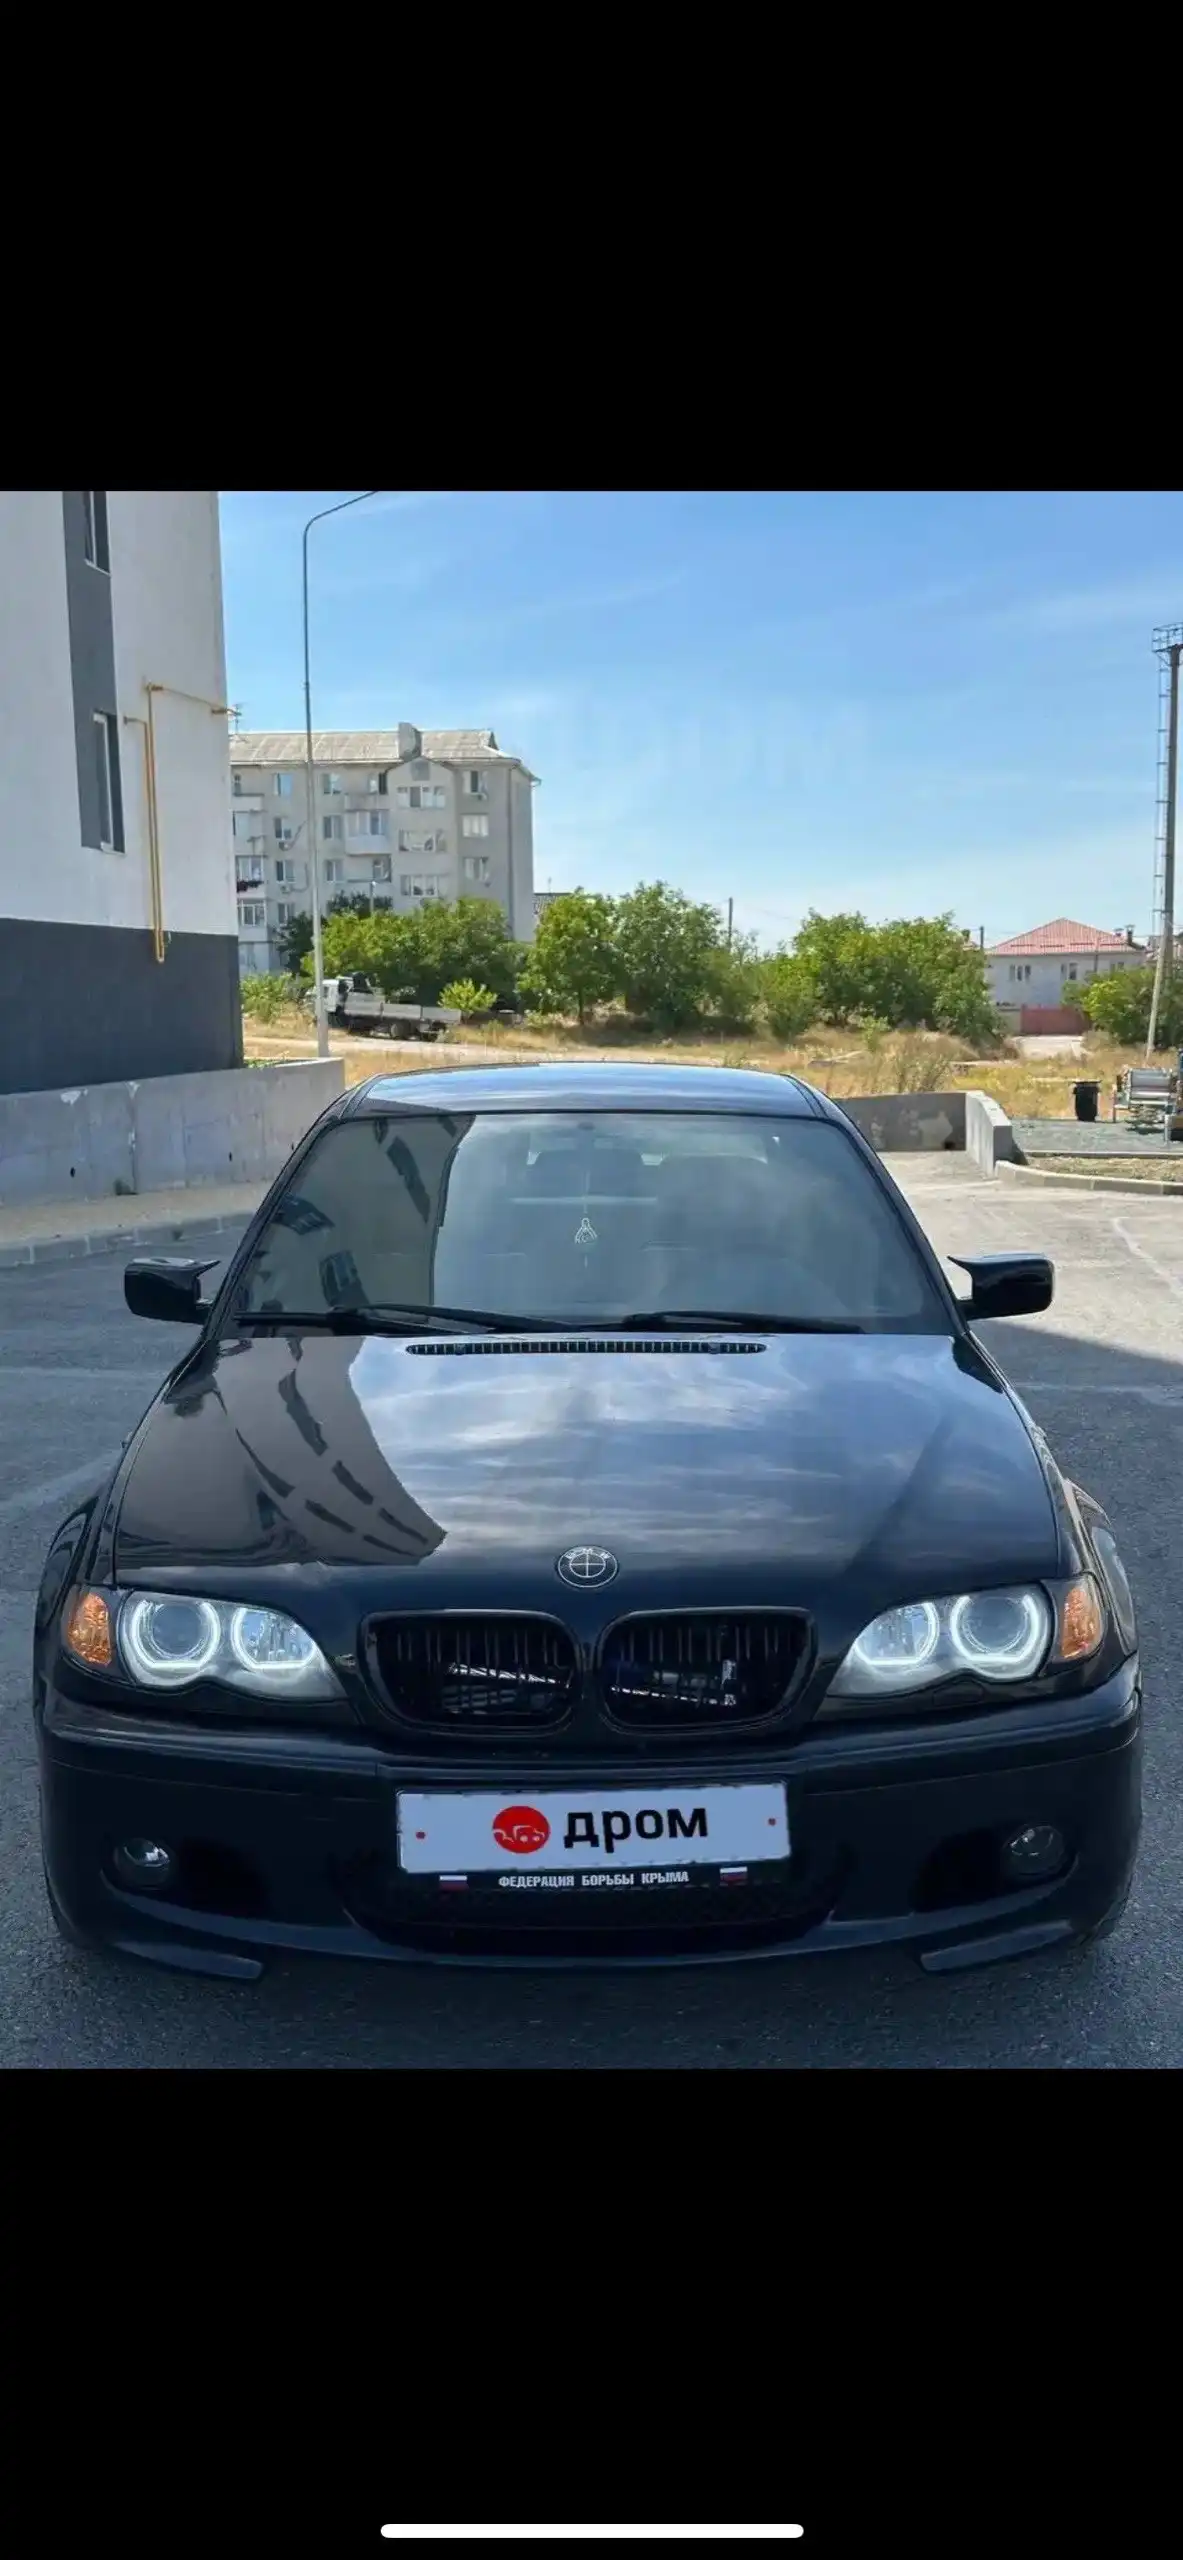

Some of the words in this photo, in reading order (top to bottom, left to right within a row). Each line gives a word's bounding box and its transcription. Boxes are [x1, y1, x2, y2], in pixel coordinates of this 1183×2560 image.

[498, 1875, 575, 1888] ФЕДЕРАЦИЯ
[581, 1873, 635, 1886] БОРЬБЫ
[641, 1871, 690, 1884] КРЫМА
